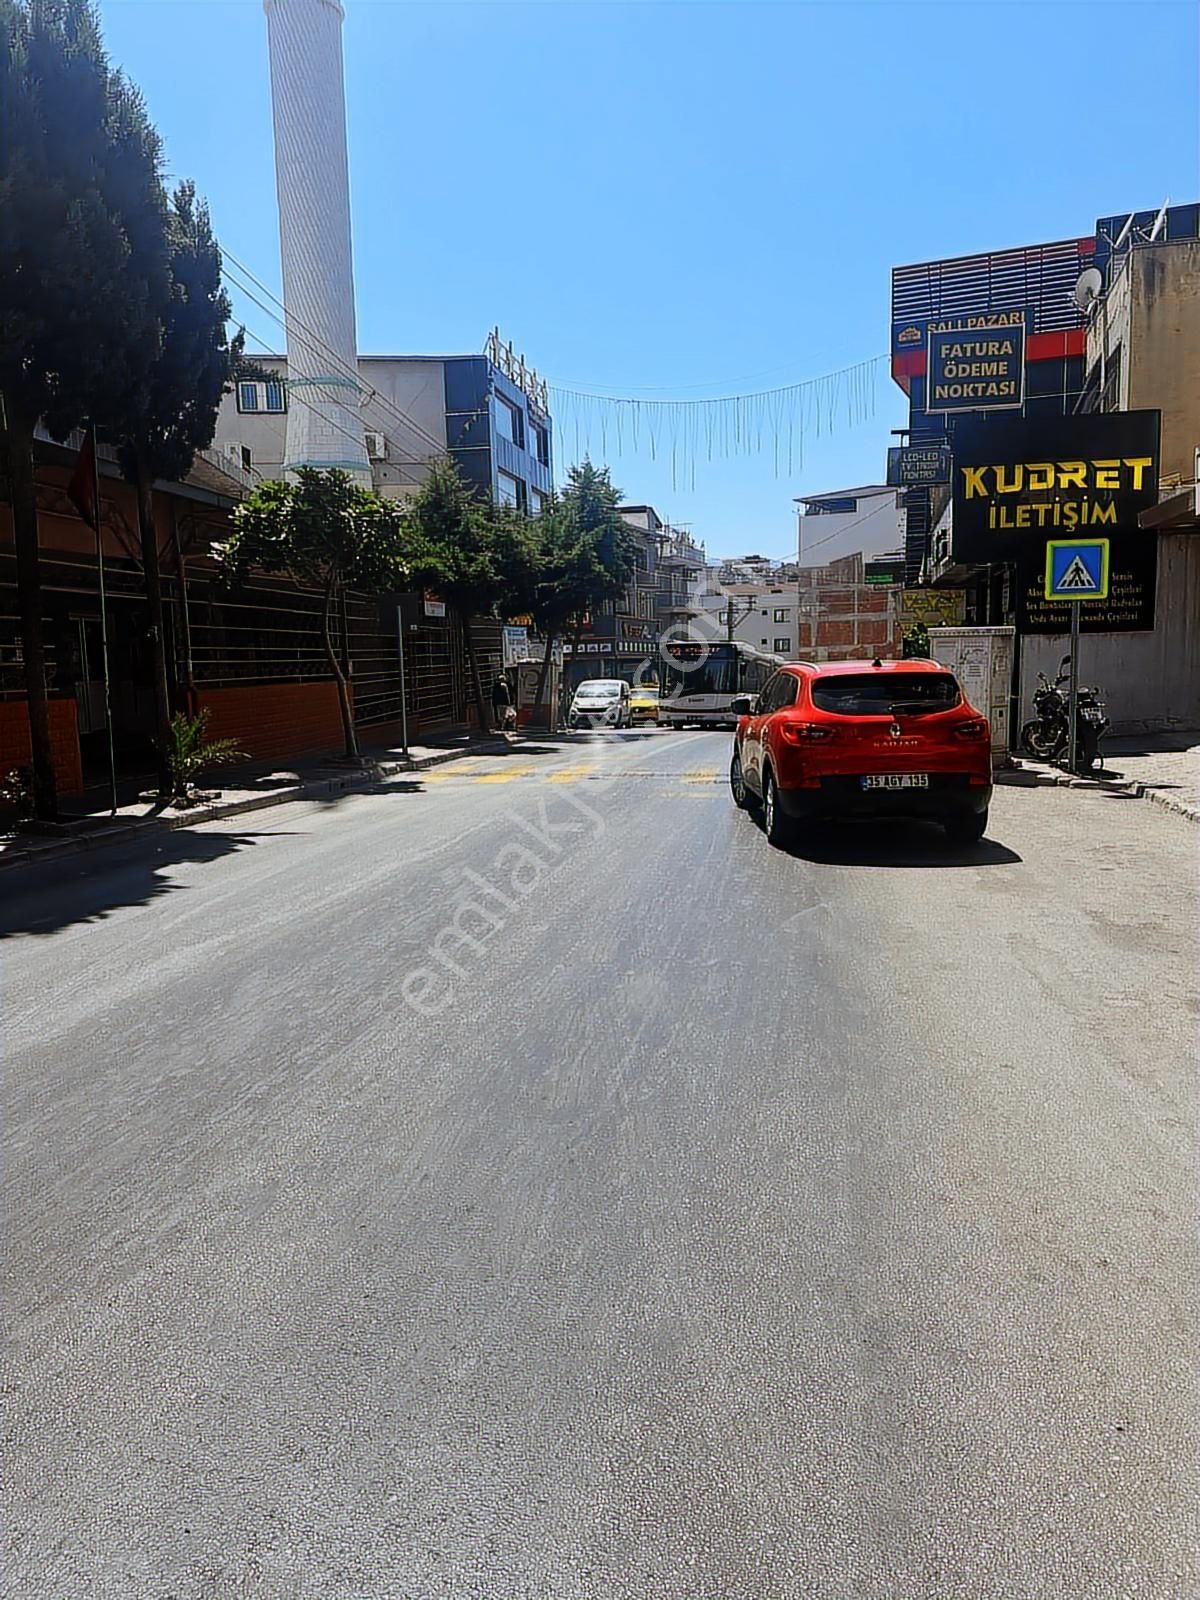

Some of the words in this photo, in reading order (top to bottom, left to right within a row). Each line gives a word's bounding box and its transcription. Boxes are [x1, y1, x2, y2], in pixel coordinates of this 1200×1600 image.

[967, 311, 1025, 328] PAZARI
[941, 341, 1013, 358] FATURA
[944, 360, 1008, 378] ÖDEME
[935, 381, 1016, 399] NOKTASI
[961, 457, 1152, 500] KUDRET
[989, 495, 1118, 532] İLETİŞİM
[868, 776, 881, 786] 35
